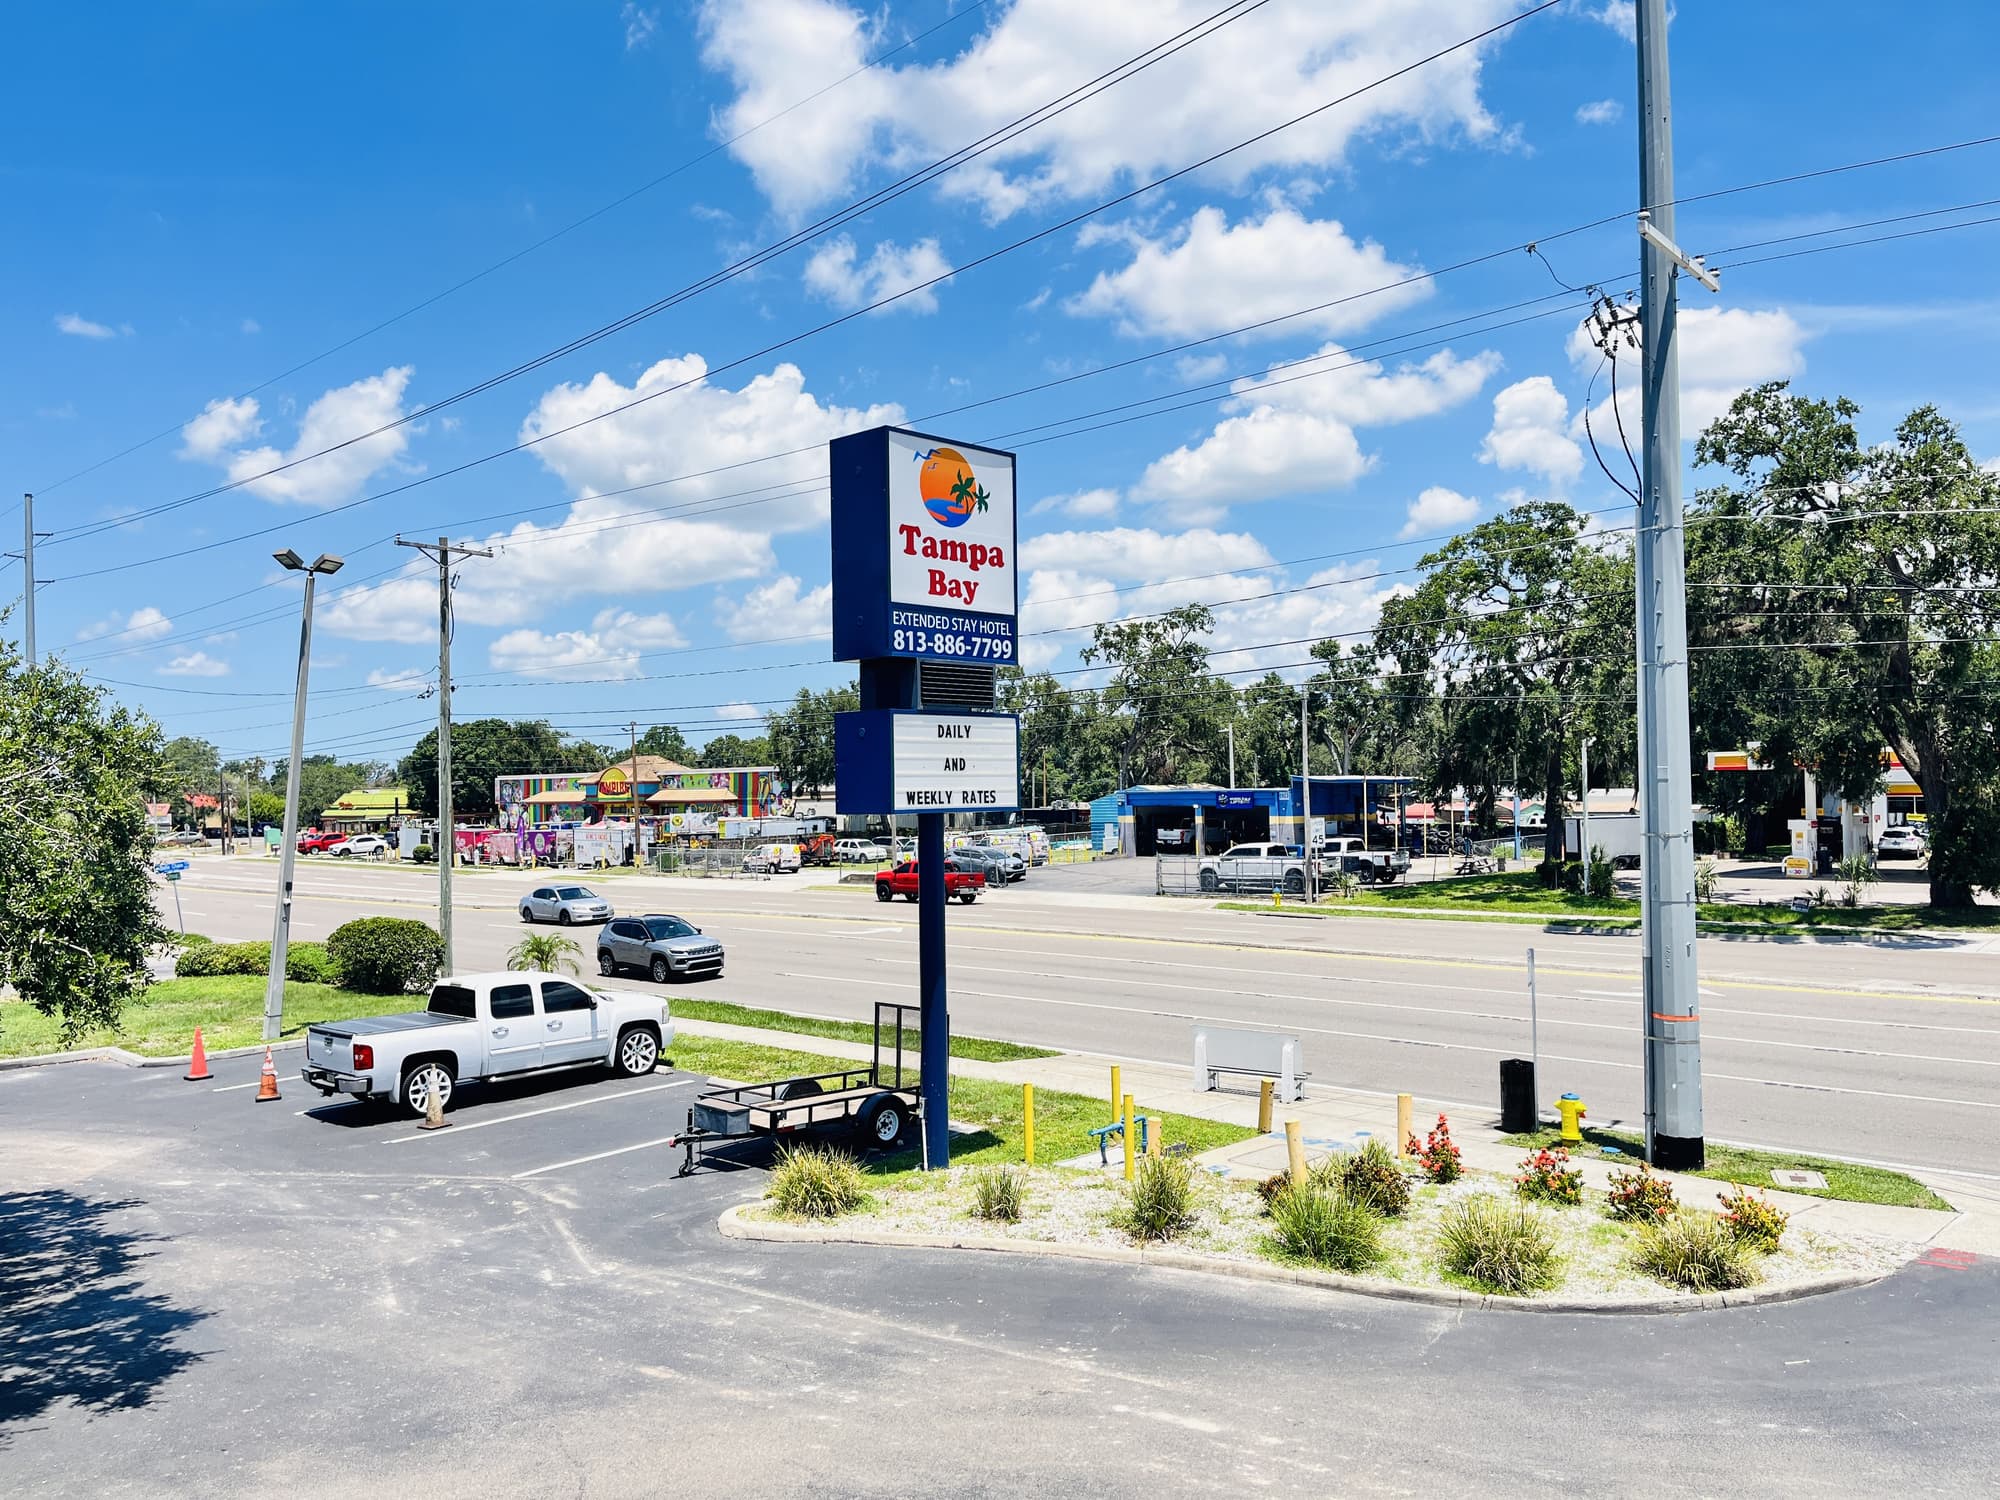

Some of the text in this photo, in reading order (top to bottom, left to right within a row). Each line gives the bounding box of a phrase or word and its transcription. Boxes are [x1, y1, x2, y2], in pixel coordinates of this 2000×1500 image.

[899, 524, 1005, 571] Tampa
[928, 569, 979, 605] Bay
[893, 611, 1012, 636] EXTENDED STAY HOTEL
[893, 629, 1012, 659] 813-886-7799
[937, 724, 971, 739] DAILY
[944, 757, 966, 771] AND
[906, 790, 996, 805] WEEKLY RATES
[1312, 834, 1324, 845] 45
